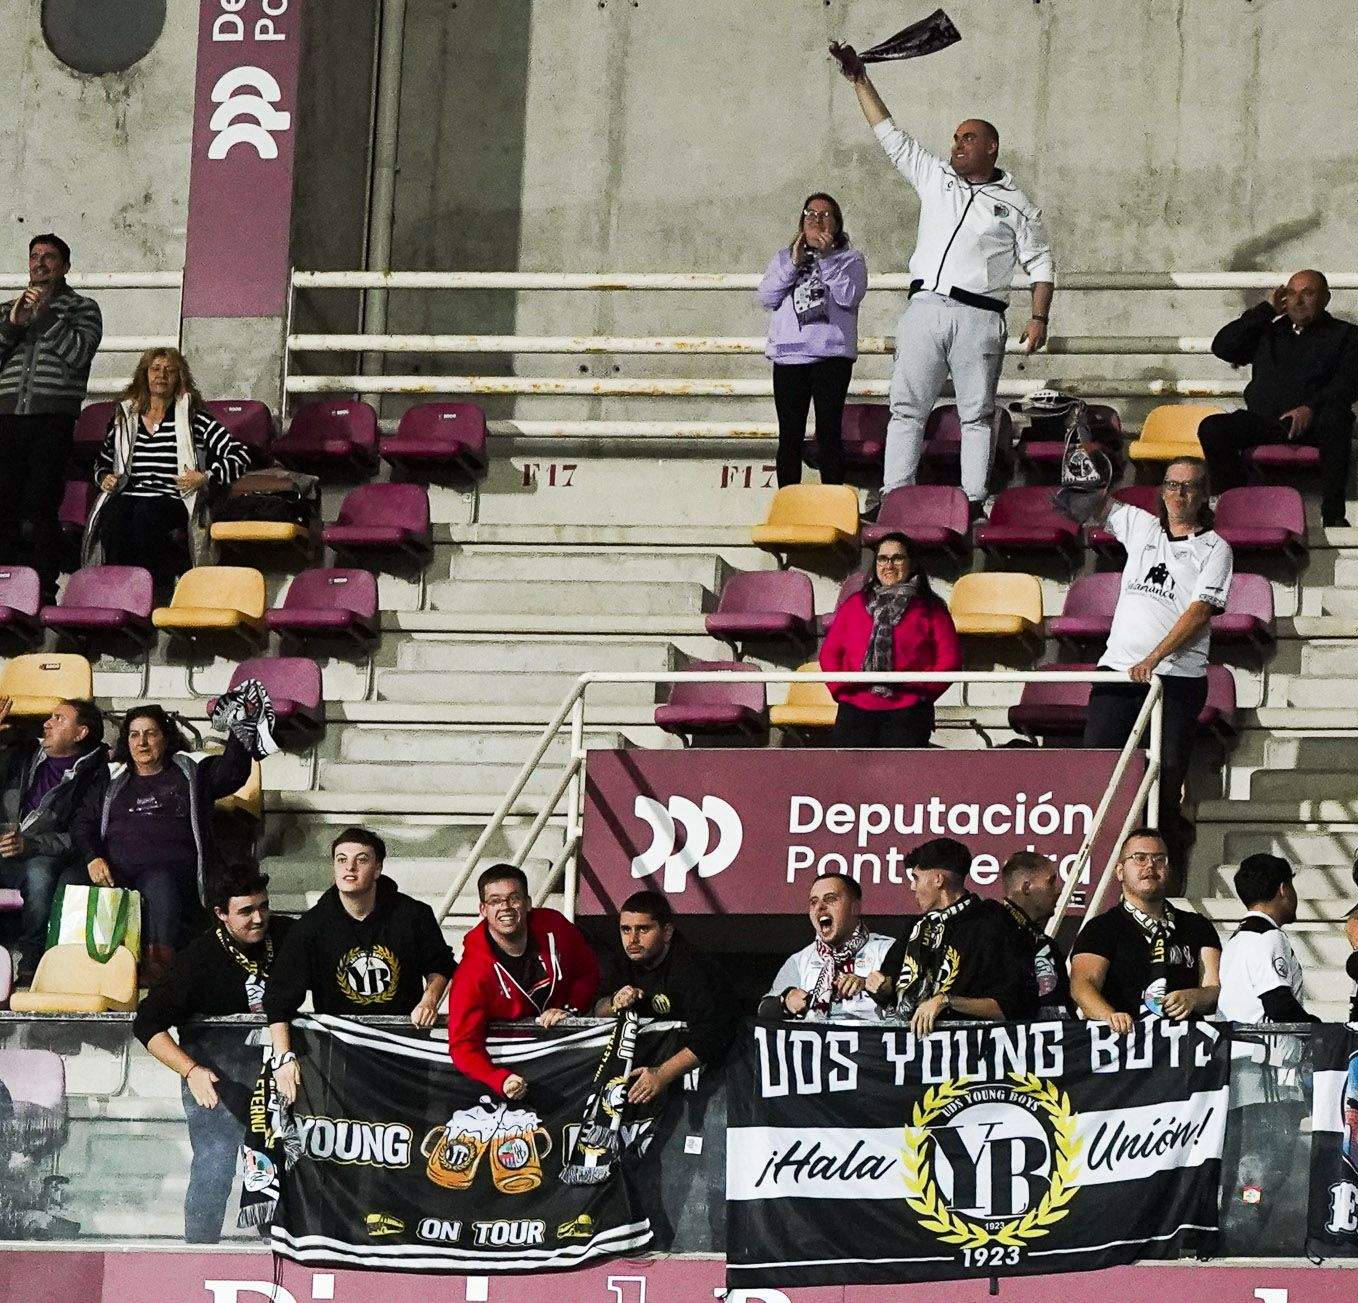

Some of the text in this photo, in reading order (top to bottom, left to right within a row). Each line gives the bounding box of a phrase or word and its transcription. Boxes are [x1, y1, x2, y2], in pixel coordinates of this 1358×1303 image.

[522, 463, 578, 487] F17
[721, 464, 778, 489] F17
[789, 791, 1094, 847] Deputación
[786, 845, 1091, 885] Pontera
[754, 1025, 858, 1097] UDS
[882, 1021, 1063, 1085] YOUNG
[942, 1089, 1040, 1117] UDS YOUNG BOYS
[298, 1116, 412, 1165] YOUNG
[1087, 1107, 1215, 1174] Unión!
[755, 1138, 900, 1188] ¡Hala
[924, 1121, 1053, 1218] YB
[419, 1218, 545, 1245] ON TOUR
[985, 1221, 1005, 1231] 1923
[962, 1247, 1021, 1268] 1923
